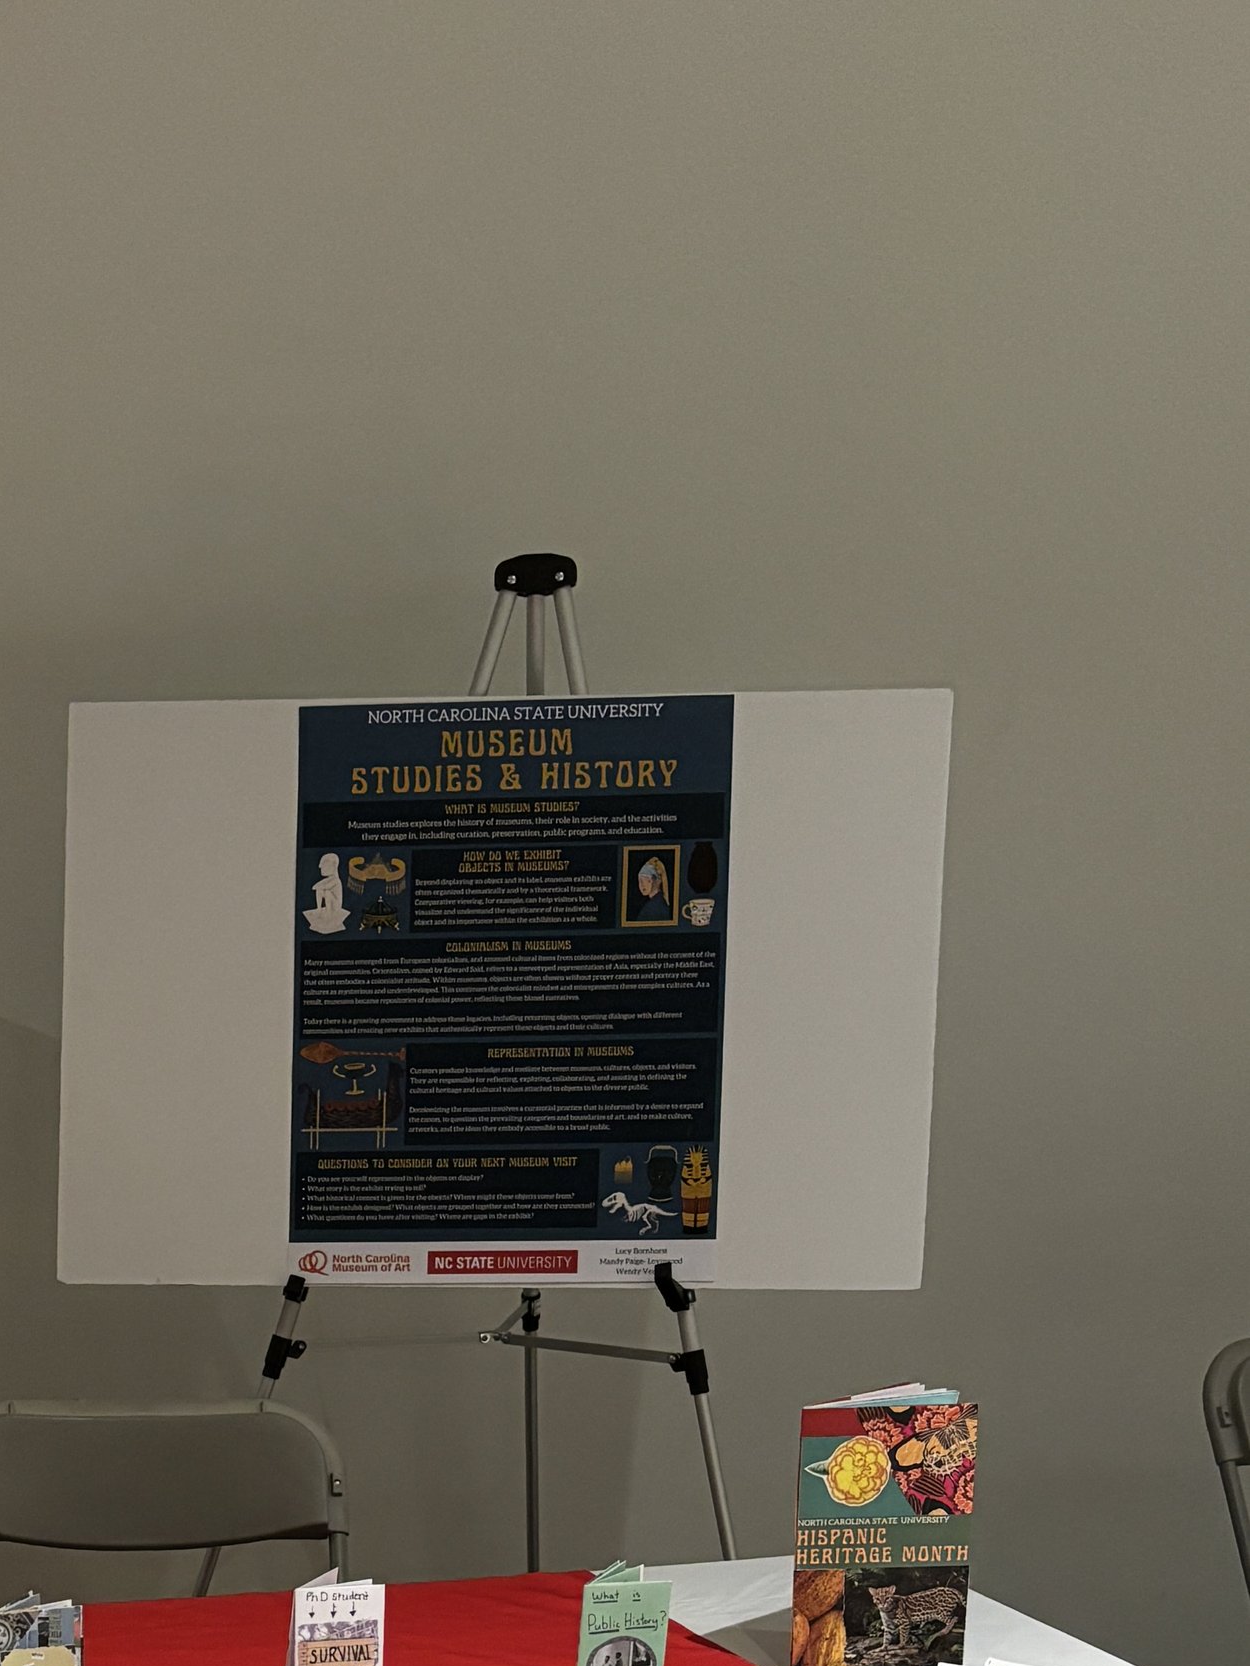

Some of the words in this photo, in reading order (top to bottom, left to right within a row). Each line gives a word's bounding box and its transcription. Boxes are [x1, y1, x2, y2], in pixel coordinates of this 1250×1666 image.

[368, 709, 424, 725] NORTH
[427, 707, 510, 723] CAROLINA
[514, 706, 564, 721] STATE
[568, 703, 663, 720] UNIVERSITY
[441, 728, 572, 757] MUSEUM
[351, 764, 481, 795] STUDIES
[500, 763, 521, 791] &
[541, 759, 677, 790] HISTORY
[445, 804, 474, 814] WHAT
[477, 804, 486, 814] IS
[490, 803, 530, 813] MUSEUM
[534, 802, 579, 813] STUDIES?
[348, 820, 381, 829] Museum
[382, 819, 409, 828] studies
[409, 818, 442, 830] explores
[443, 818, 456, 827] the
[457, 817, 484, 829] history
[485, 817, 494, 826] of
[495, 819, 534, 828] museums,
[535, 816, 554, 825] their
[555, 816, 570, 824] role
[571, 815, 579, 824] in
[581, 815, 610, 826] society,
[610, 814, 626, 823] and
[627, 814, 640, 823] the
[641, 813, 677, 822] activities
[361, 831, 379, 843] they
[380, 833, 407, 842] engage
[408, 830, 418, 842] in,
[419, 830, 455, 841] including
[456, 829, 489, 840] curation,
[491, 828, 541, 840] preservation,
[543, 827, 566, 839] public
[568, 829, 606, 838] programs,
[607, 826, 622, 835] and
[623, 825, 663, 834] education.
[463, 851, 485, 862] HOW
[488, 851, 501, 861] DO
[505, 850, 520, 861] WE
[523, 849, 561, 860] EXHIBIT
[458, 862, 501, 873] OBJECTS
[504, 862, 514, 872] IN
[517, 860, 569, 872] MUSEUMS?
[446, 942, 508, 952] COLONIALISM
[512, 941, 521, 951] IN
[524, 940, 571, 951] MUSEUMS
[487, 1047, 570, 1058] REPRESENTATION
[574, 1047, 584, 1057] IN
[587, 1046, 634, 1056] MUSEUMS
[317, 1158, 368, 1168] QUESTIONS
[372, 1158, 384, 1168] TO
[388, 1158, 432, 1168] CONSIDER
[436, 1157, 449, 1168] ON
[452, 1157, 477, 1168] YOUR
[480, 1157, 505, 1167] NEXT
[508, 1157, 549, 1167] MUSEUM
[553, 1156, 577, 1167] VISIT
[332, 1254, 362, 1263] North
[365, 1254, 410, 1263] Carolina
[615, 1248, 632, 1256] Lucy
[332, 1264, 378, 1272] Museum
[380, 1264, 391, 1272] of
[394, 1263, 410, 1272] Art
[434, 1257, 452, 1269] NC
[456, 1256, 494, 1269] STATE
[497, 1256, 571, 1269] UNIVERSITY
[797, 1518, 828, 1527] NORTH
[828, 1517, 872, 1526] CAROLINA
[872, 1516, 898, 1525] STATE
[900, 1515, 950, 1524] UNIVERSITY
[796, 1527, 887, 1546] HISPANIC
[796, 1547, 892, 1566] HERITAGE
[902, 1545, 969, 1563] MONTH
[592, 1590, 619, 1600] What
[632, 1590, 641, 1598] is
[588, 1613, 620, 1631] Public
[624, 1610, 667, 1632] History?
[310, 1644, 371, 1664] SURVIVAL
